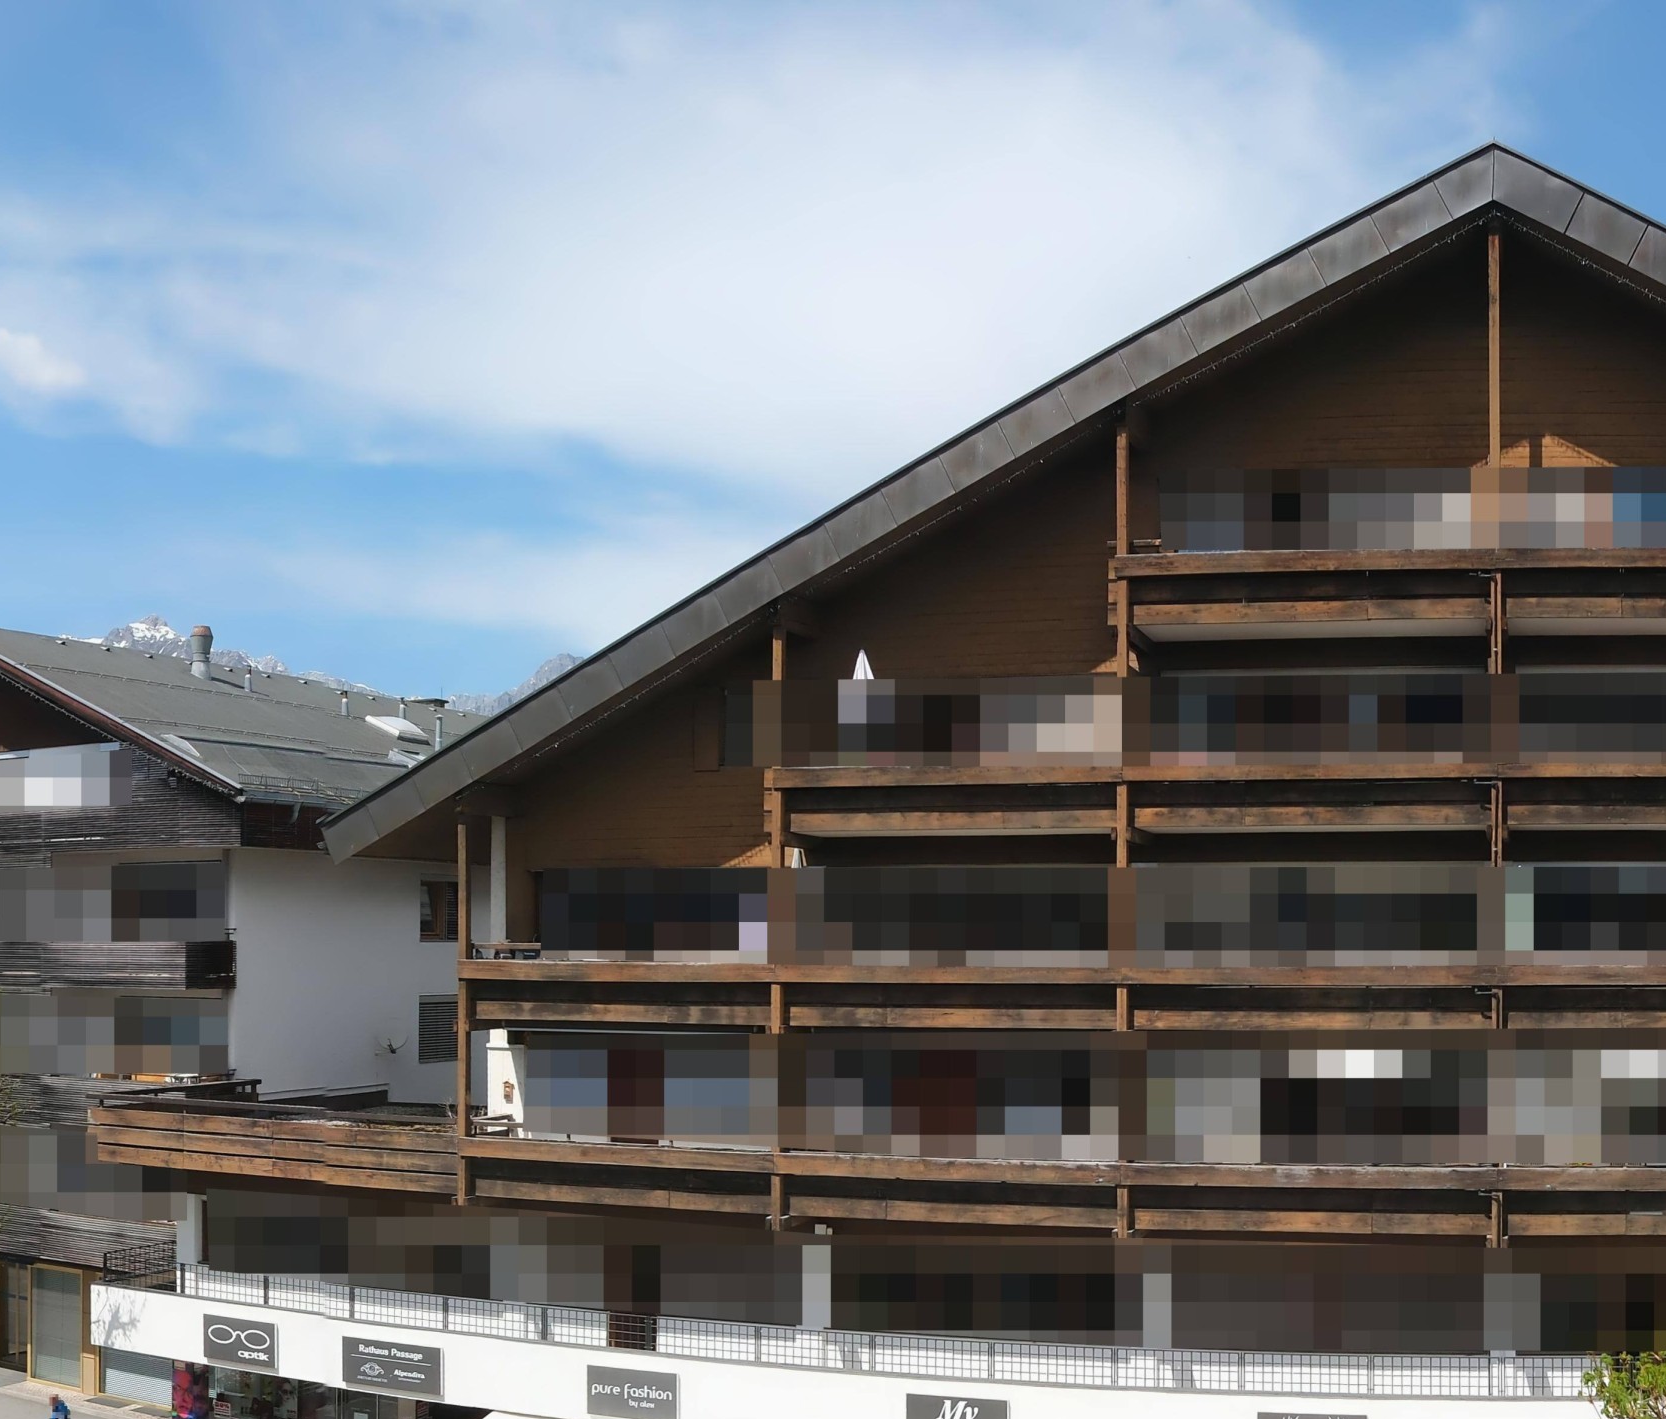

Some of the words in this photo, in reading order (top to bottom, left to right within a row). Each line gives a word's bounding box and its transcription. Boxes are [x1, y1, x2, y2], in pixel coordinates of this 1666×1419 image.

[237, 1349, 270, 1362] optik
[358, 1344, 389, 1357] Rathaus
[390, 1348, 423, 1361] Passage
[393, 1369, 426, 1379] Alpendiva
[591, 1383, 621, 1396] pure
[624, 1383, 673, 1401] fashion
[628, 1399, 639, 1409] by
